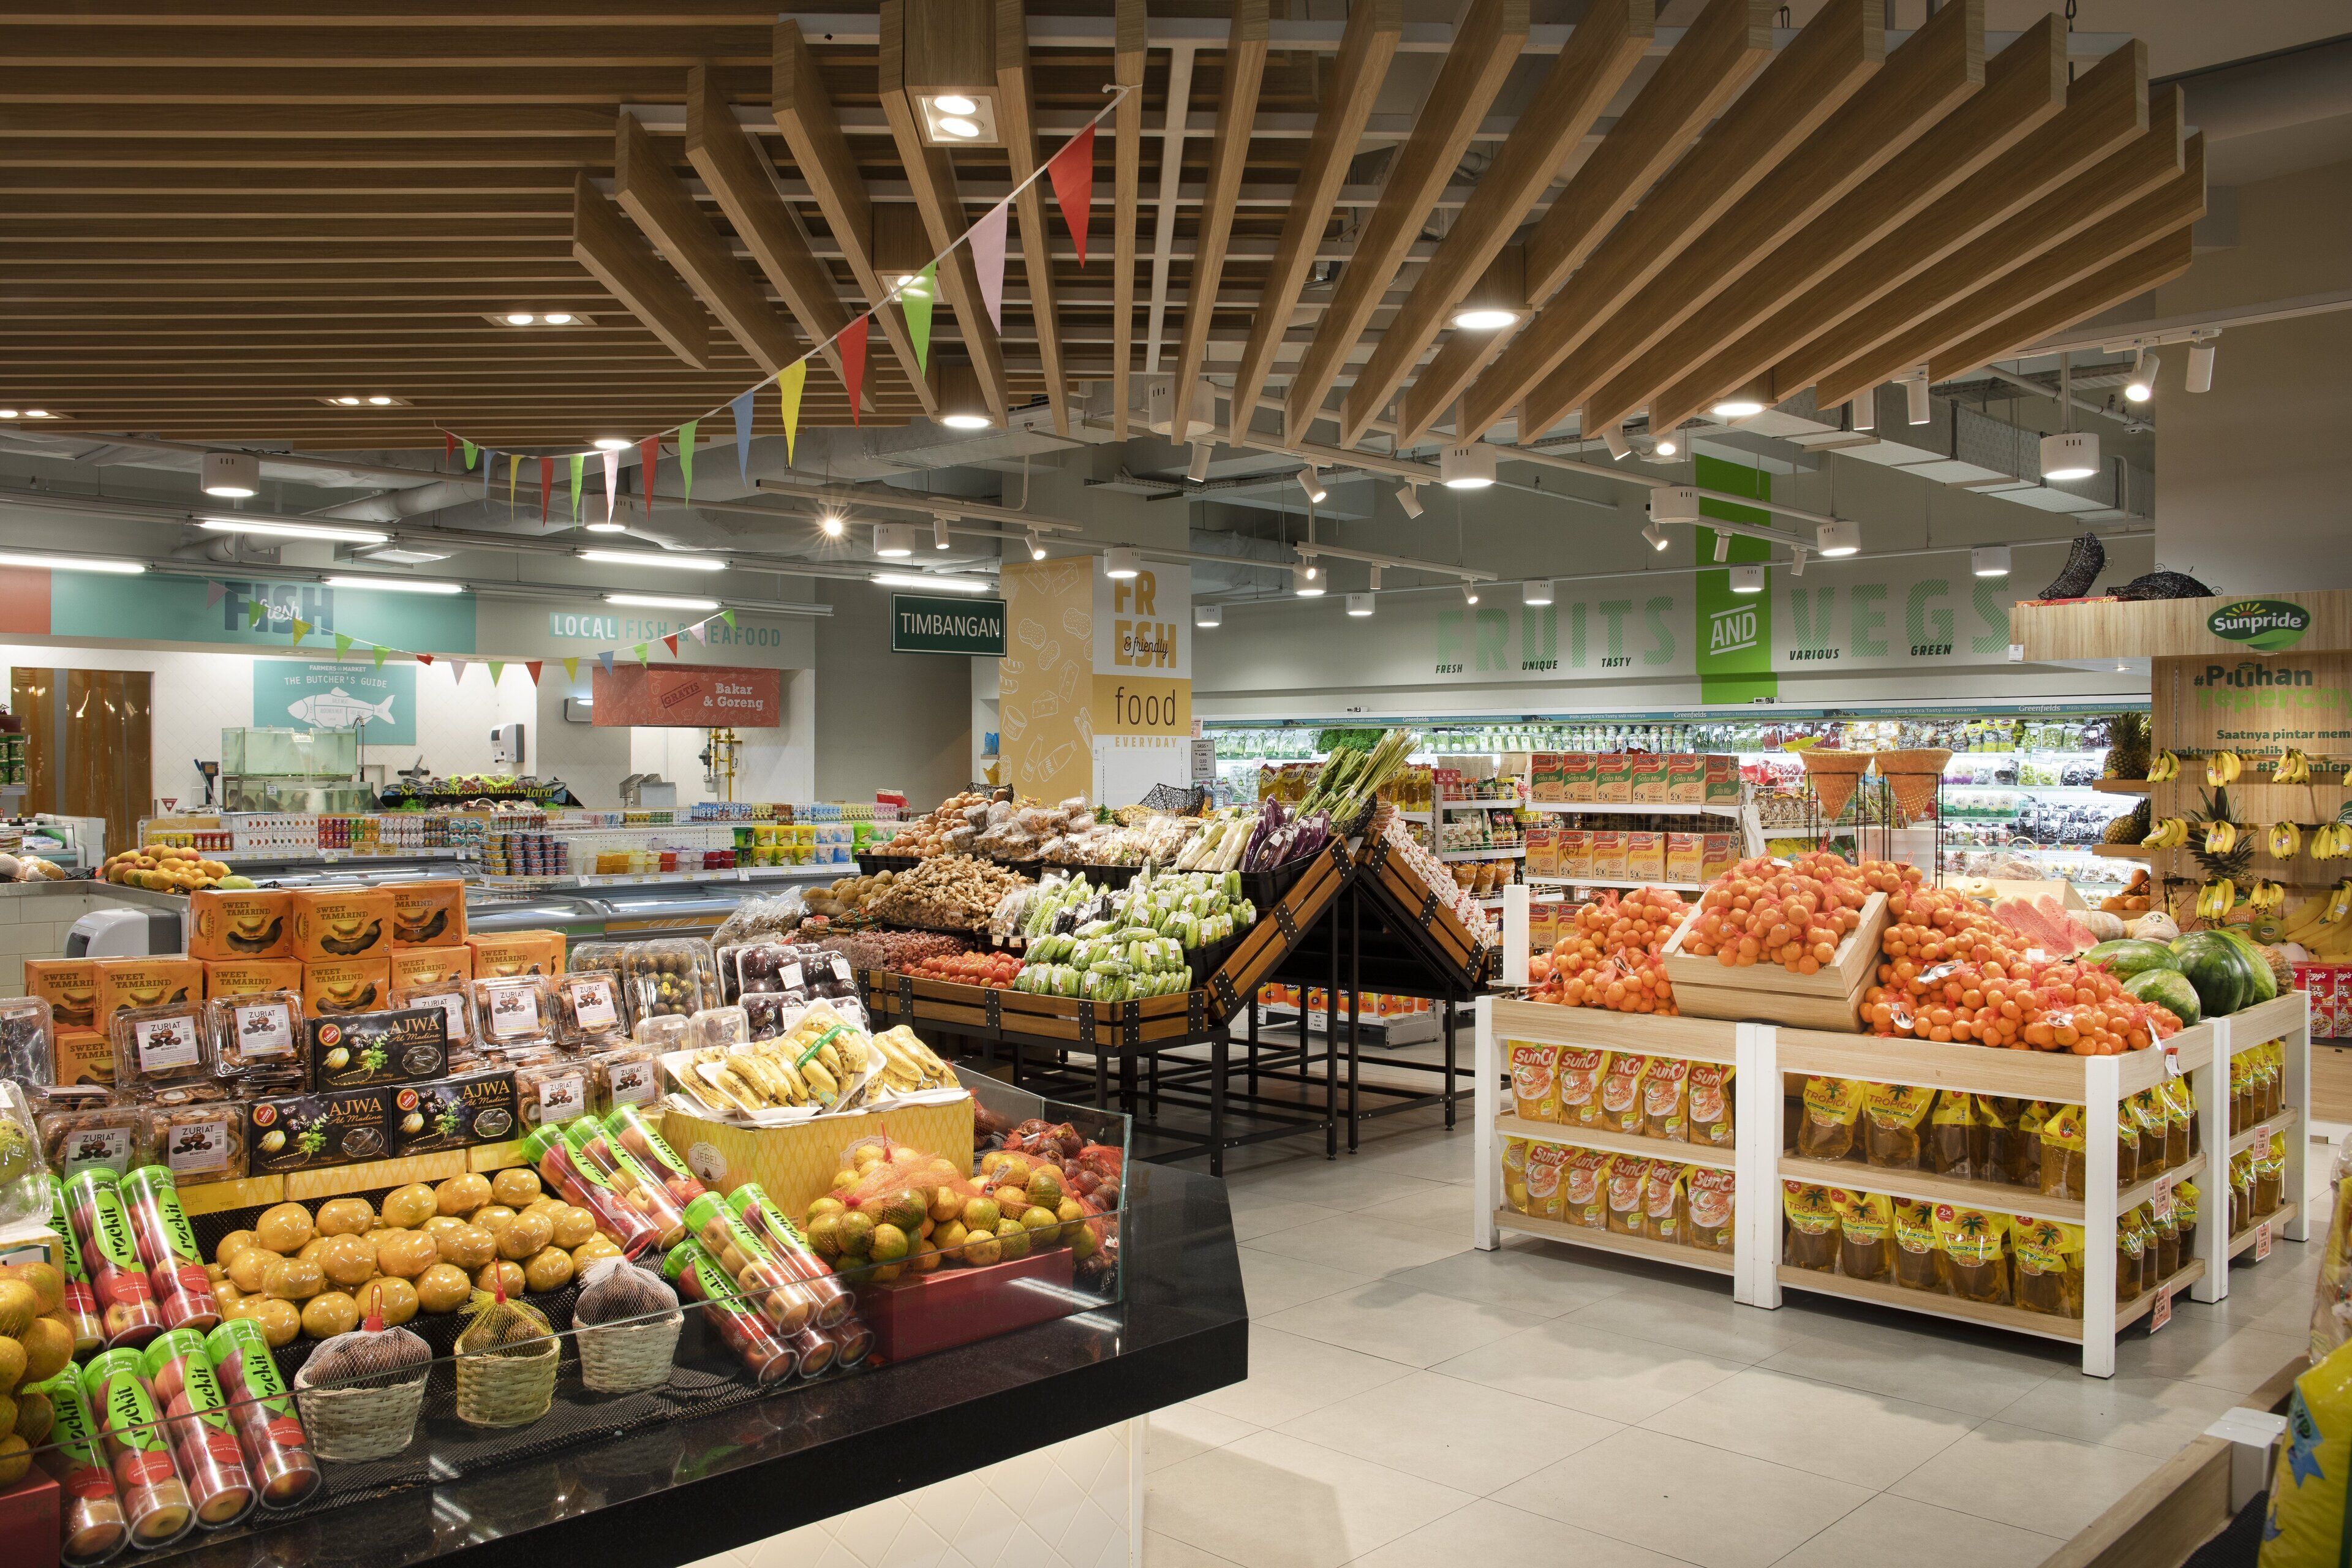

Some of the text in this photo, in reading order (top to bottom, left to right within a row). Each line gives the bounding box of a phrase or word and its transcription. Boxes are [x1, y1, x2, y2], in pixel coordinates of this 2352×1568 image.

[1114, 570, 1156, 616] FR
[224, 582, 333, 636] FISH
[1791, 575, 2009, 657] VEGS
[554, 615, 616, 639] LOCAL
[625, 619, 667, 639] FISH
[678, 623, 689, 641] &
[900, 612, 1000, 638] TIMBANGAN
[2214, 612, 2301, 635] Sunpride
[1437, 596, 1676, 671] FRUITS
[1710, 612, 1757, 649] AND
[1114, 620, 1177, 669] ESH
[1124, 636, 1169, 660] & friendly
[1911, 644, 1951, 656] GREEN
[1789, 648, 1839, 661] VARIOUS
[1436, 664, 1463, 673] FRESH
[1522, 660, 1558, 671] UNIQUE
[1601, 657, 1632, 668] TASTY
[284, 676, 387, 688] THE BUTCHER'S GUIDE
[2194, 664, 2313, 687] #Pilihan
[662, 682, 699, 704] GRATIS
[715, 683, 753, 695] Bakar
[703, 696, 763, 710] & Goreng
[1115, 687, 1176, 726] food
[1115, 736, 1177, 748] EVERYDAY
[2217, 729, 2269, 742] Saatnya
[2273, 729, 2315, 742] pintar
[320, 911, 368, 919] TAMARIND
[398, 959, 425, 968] SWEET
[485, 955, 528, 963] TAMARIND
[311, 968, 341, 976] SWEET
[402, 963, 447, 974] TAMARIND
[110, 973, 145, 981] SWEET
[315, 973, 363, 982] TAMARIND
[115, 979, 172, 989] TAMARIND
[421, 998, 448, 1007] ZURIAT
[248, 1009, 276, 1019] ZURIAT
[151, 1022, 181, 1031] ZURIAT
[389, 1017, 440, 1035] AJWA
[323, 1029, 337, 1041] Luxury
[70, 1043, 105, 1052] SWEET
[796, 1040, 821, 1067] VEGETABLES
[1515, 1048, 1555, 1066] SunCo
[1562, 1052, 1598, 1069] SunCo
[620, 1066, 643, 1076] ZURIAT
[1647, 1063, 1685, 1080] SunCo
[462, 1080, 510, 1099] AJWA
[550, 1081, 572, 1091] ZURIAT
[402, 1093, 415, 1107] Luxury
[462, 1099, 476, 1107] Al
[1806, 1088, 1853, 1109] TROPICAL
[329, 1098, 383, 1117] AJWA
[260, 1107, 271, 1122] Luxury
[182, 1125, 214, 1135] ZURIAT
[83, 1133, 116, 1142] ZURIAT
[695, 1150, 720, 1167] JEBEL
[101, 1205, 130, 1257] rockit
[164, 1202, 193, 1250] rockit
[1942, 1232, 1999, 1243] TROPICAL
[114, 1385, 148, 1438] rockit
[57, 1398, 91, 1451] rockit
[134, 1469, 146, 1477] New
